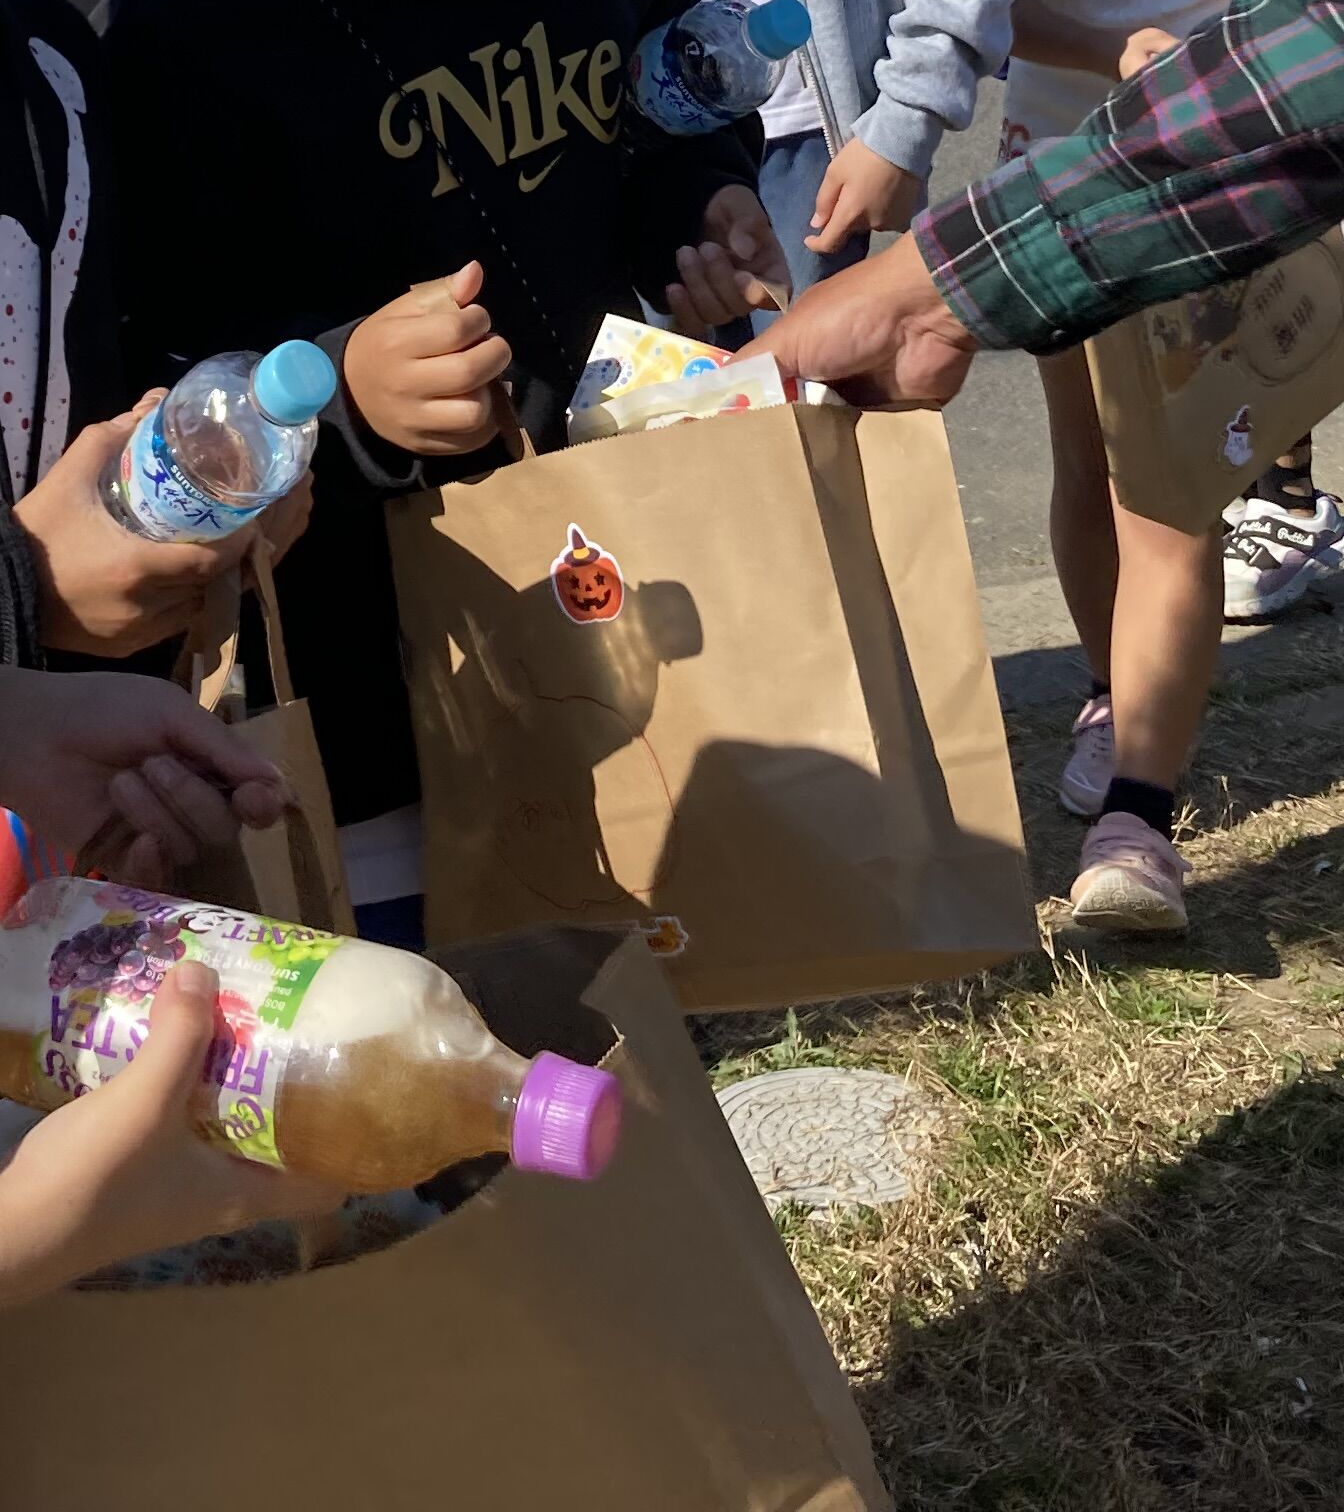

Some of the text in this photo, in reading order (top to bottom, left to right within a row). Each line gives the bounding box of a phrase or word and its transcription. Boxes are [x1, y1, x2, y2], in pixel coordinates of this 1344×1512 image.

[379, 21, 622, 197] Nike
[142, 458, 223, 530] 天然水
[51, 995, 118, 1059] TEA
